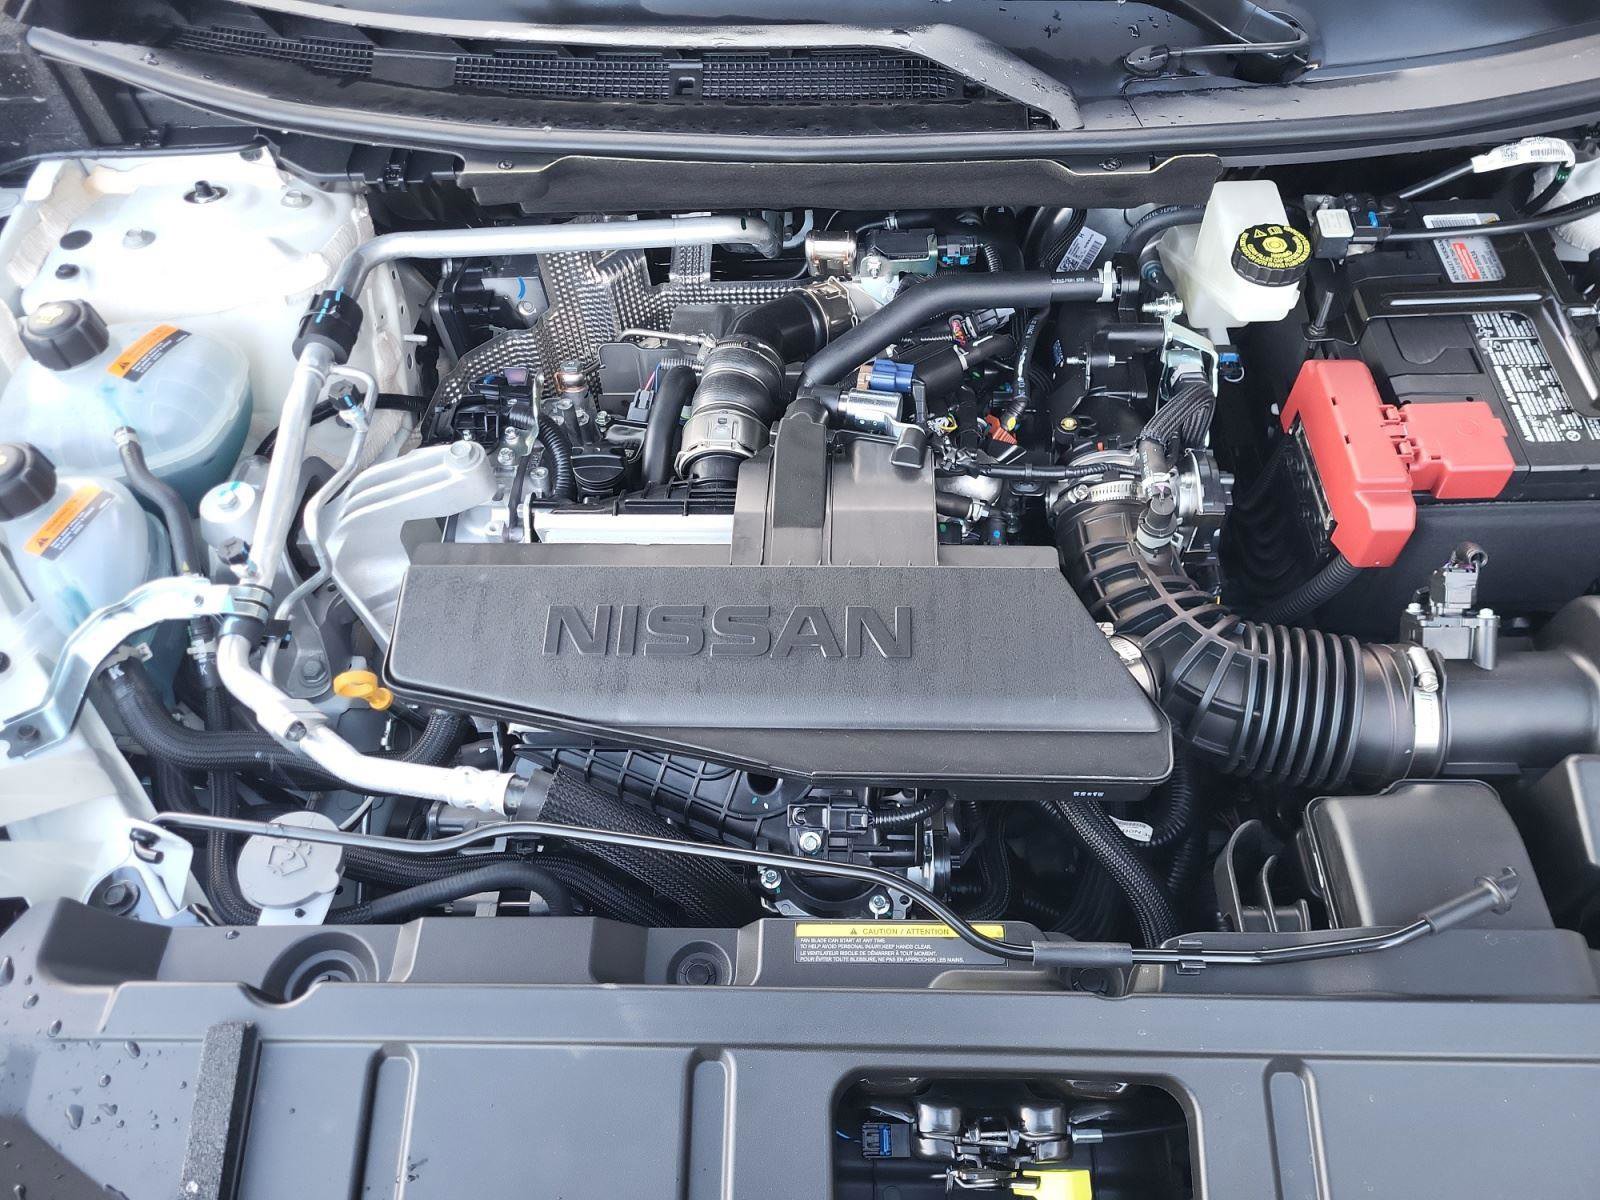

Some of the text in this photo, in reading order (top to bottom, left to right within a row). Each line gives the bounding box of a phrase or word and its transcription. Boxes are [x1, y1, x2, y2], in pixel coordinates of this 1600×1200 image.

[542, 604, 912, 658] NISSAN
[108, 664, 125, 680] K
[200, 664, 208, 675] K
